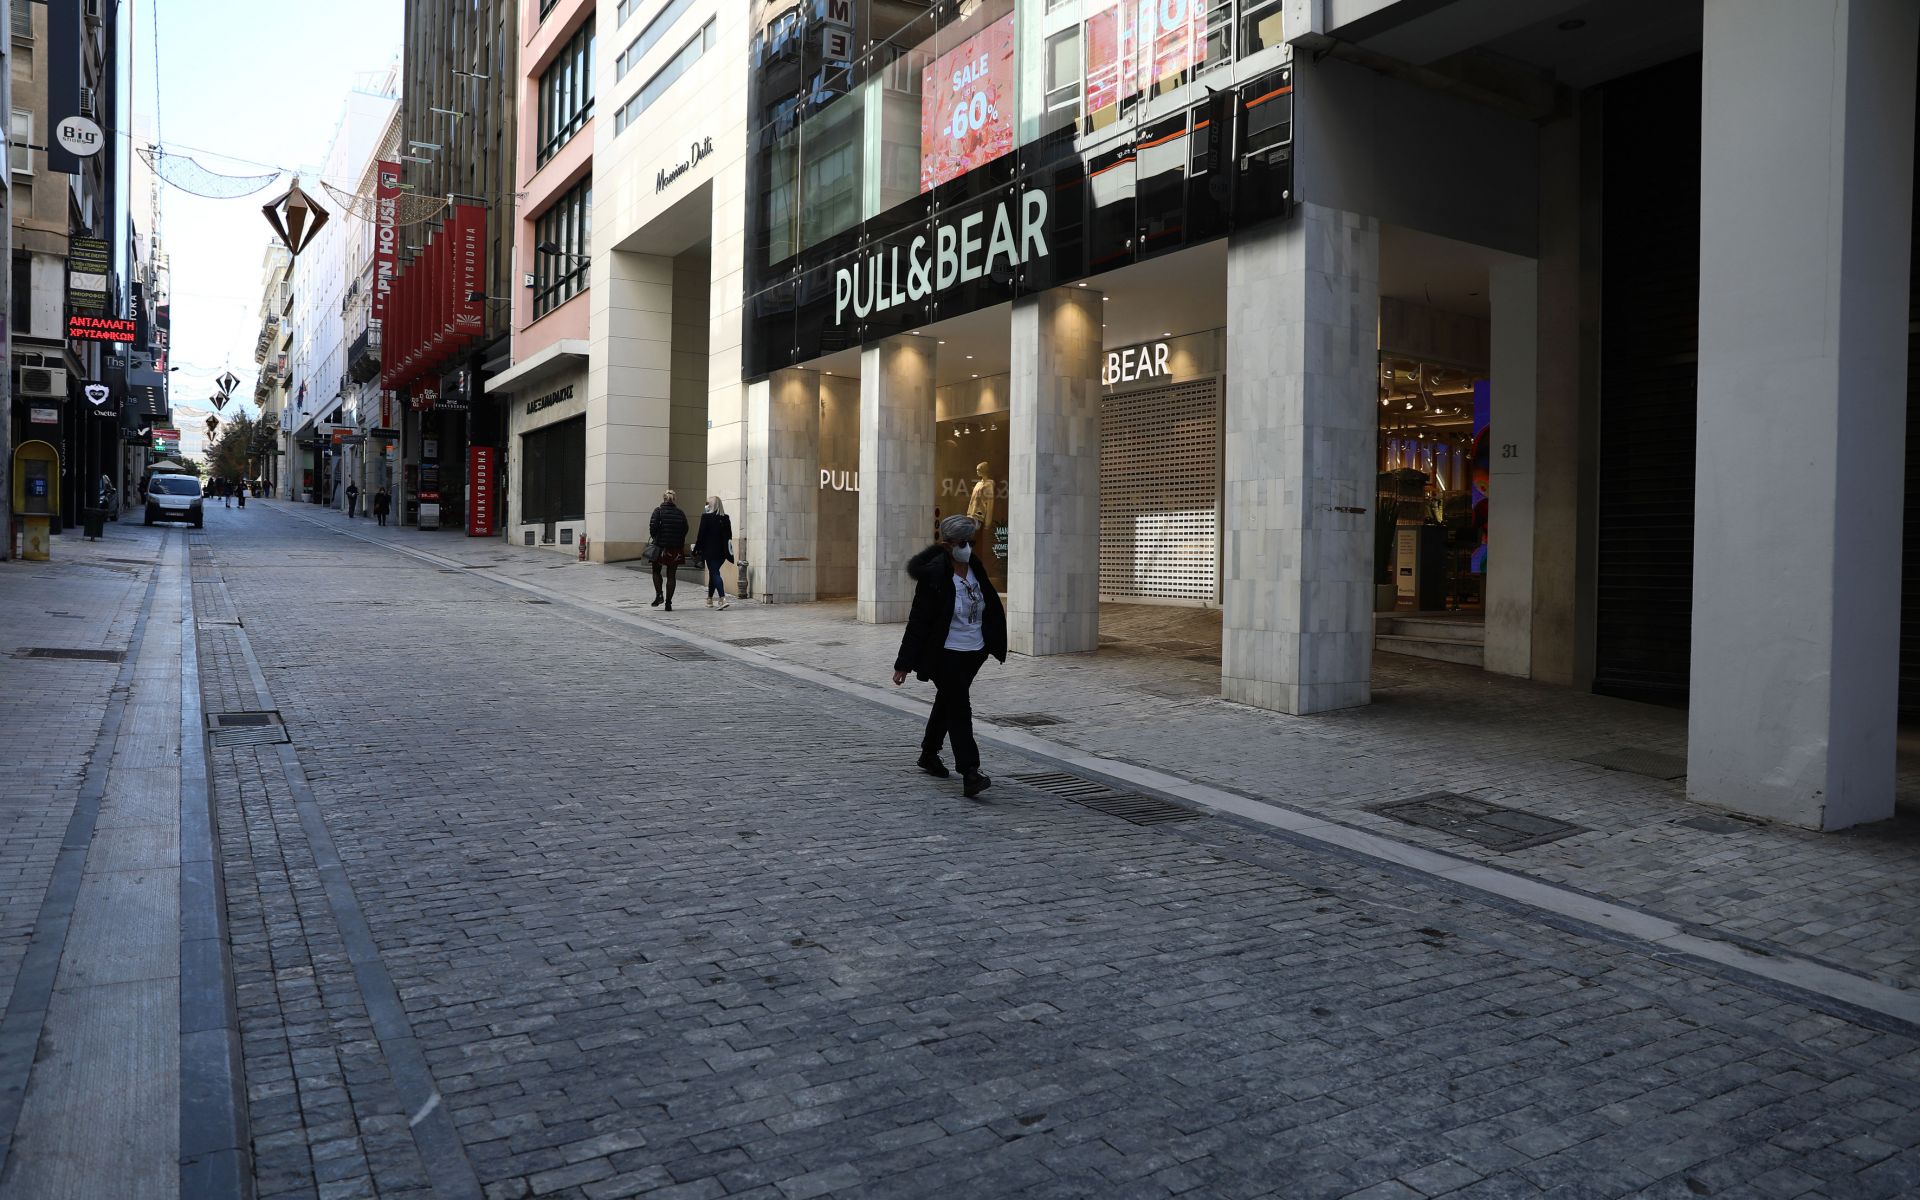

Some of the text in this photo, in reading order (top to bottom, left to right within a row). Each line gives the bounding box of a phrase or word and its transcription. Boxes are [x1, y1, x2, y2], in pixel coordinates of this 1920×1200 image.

[952, 53, 989, 91] SALE
[63, 126, 95, 144] Big
[943, 91, 998, 139] -60%
[655, 136, 714, 195] Massimo Dutti
[379, 197, 395, 255] HOUSE
[835, 188, 1049, 326] PULL&BEAR
[69, 316, 136, 331] ΑΝΤΑΛΛΑΓΗ
[69, 328, 136, 342] ΧΡΥΣΑΦΙΚΩΝ
[1101, 343, 1169, 386] BEAR
[1502, 444, 1520, 458] 31
[476, 450, 487, 525] FUNKYBUDDHA
[820, 469, 861, 491] PULL
